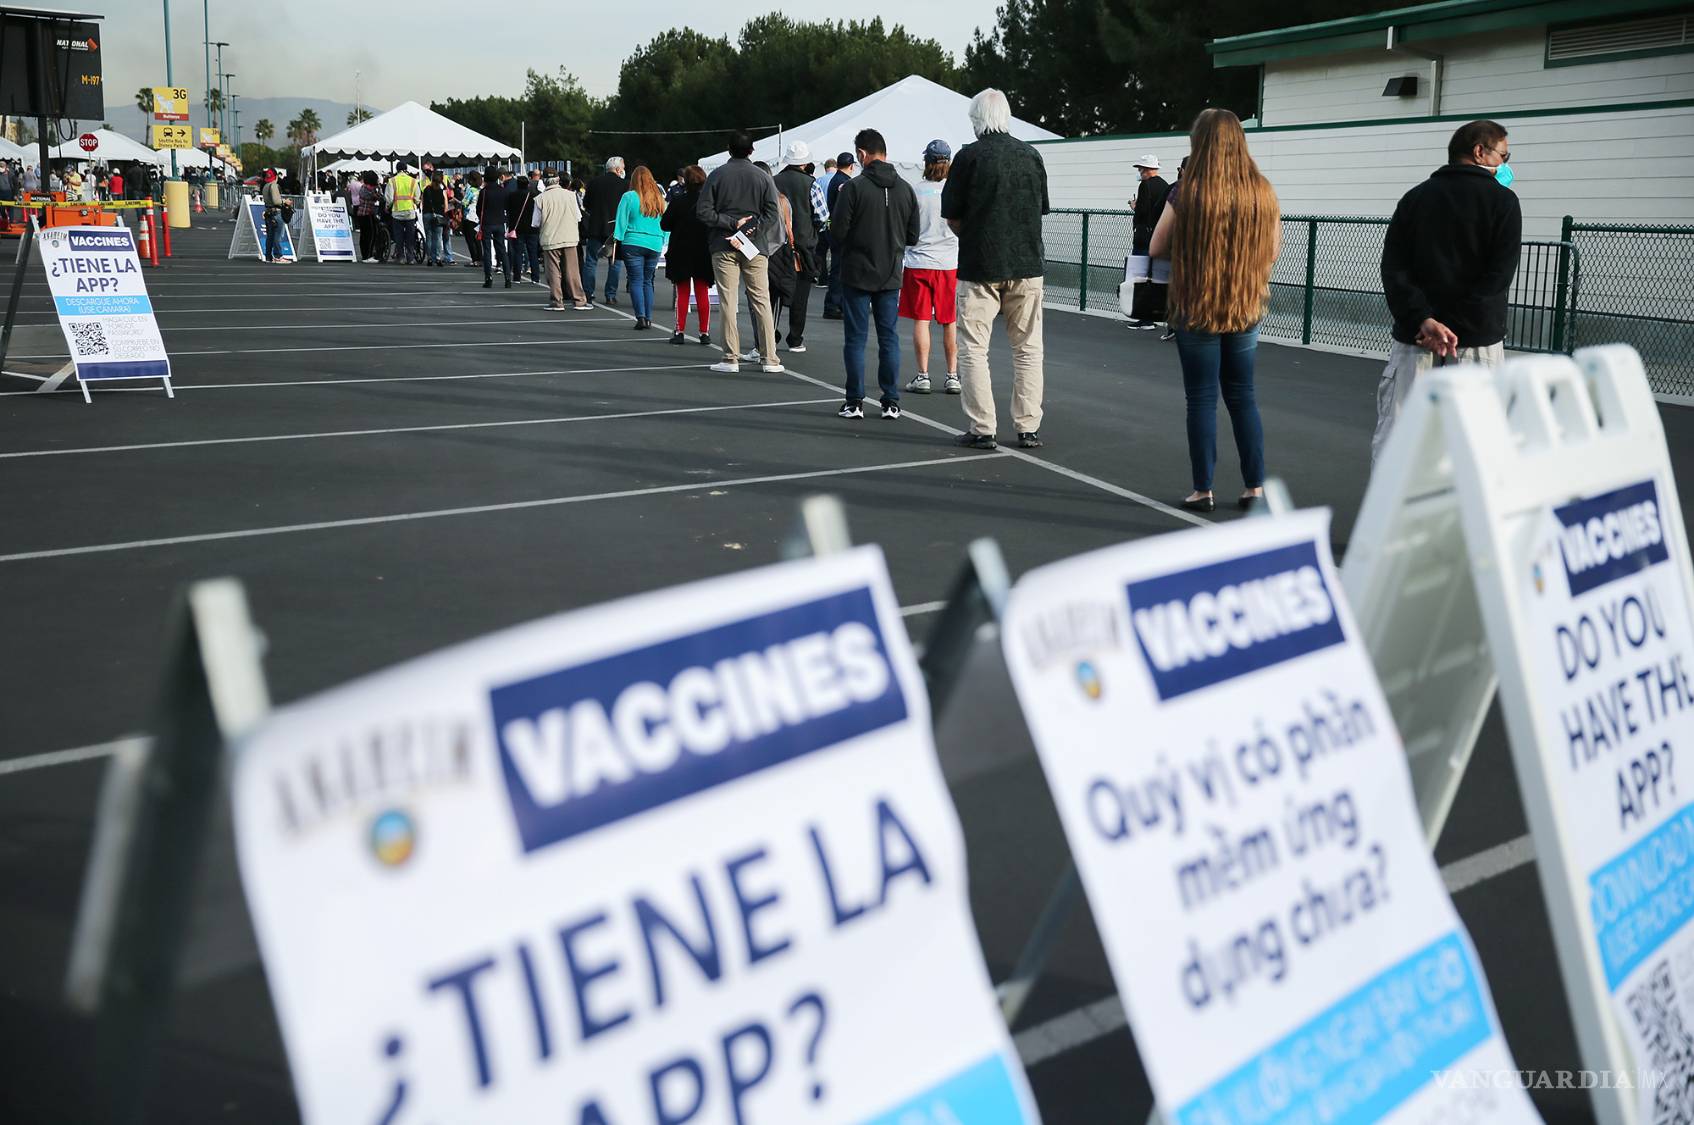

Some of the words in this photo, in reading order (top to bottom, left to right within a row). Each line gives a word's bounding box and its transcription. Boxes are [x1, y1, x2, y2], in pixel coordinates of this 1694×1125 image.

[57, 40, 88, 48] NATONAL
[173, 89, 187, 99] 3G
[80, 138, 98, 147] STOP
[51, 258, 112, 278] ¿TIENE
[114, 258, 137, 273] LA
[71, 236, 130, 247] VACCINES
[76, 277, 119, 293] APP?
[1561, 499, 1661, 574] VACCINES
[1132, 564, 1334, 673] VACCINES
[1556, 614, 1600, 681] DO
[1600, 590, 1665, 658] YOU
[503, 622, 892, 810] VACCINES
[1561, 679, 1639, 772] HAVE
[1616, 740, 1676, 831] APP?
[808, 796, 934, 927] LA
[579, 992, 828, 1125] PP?
